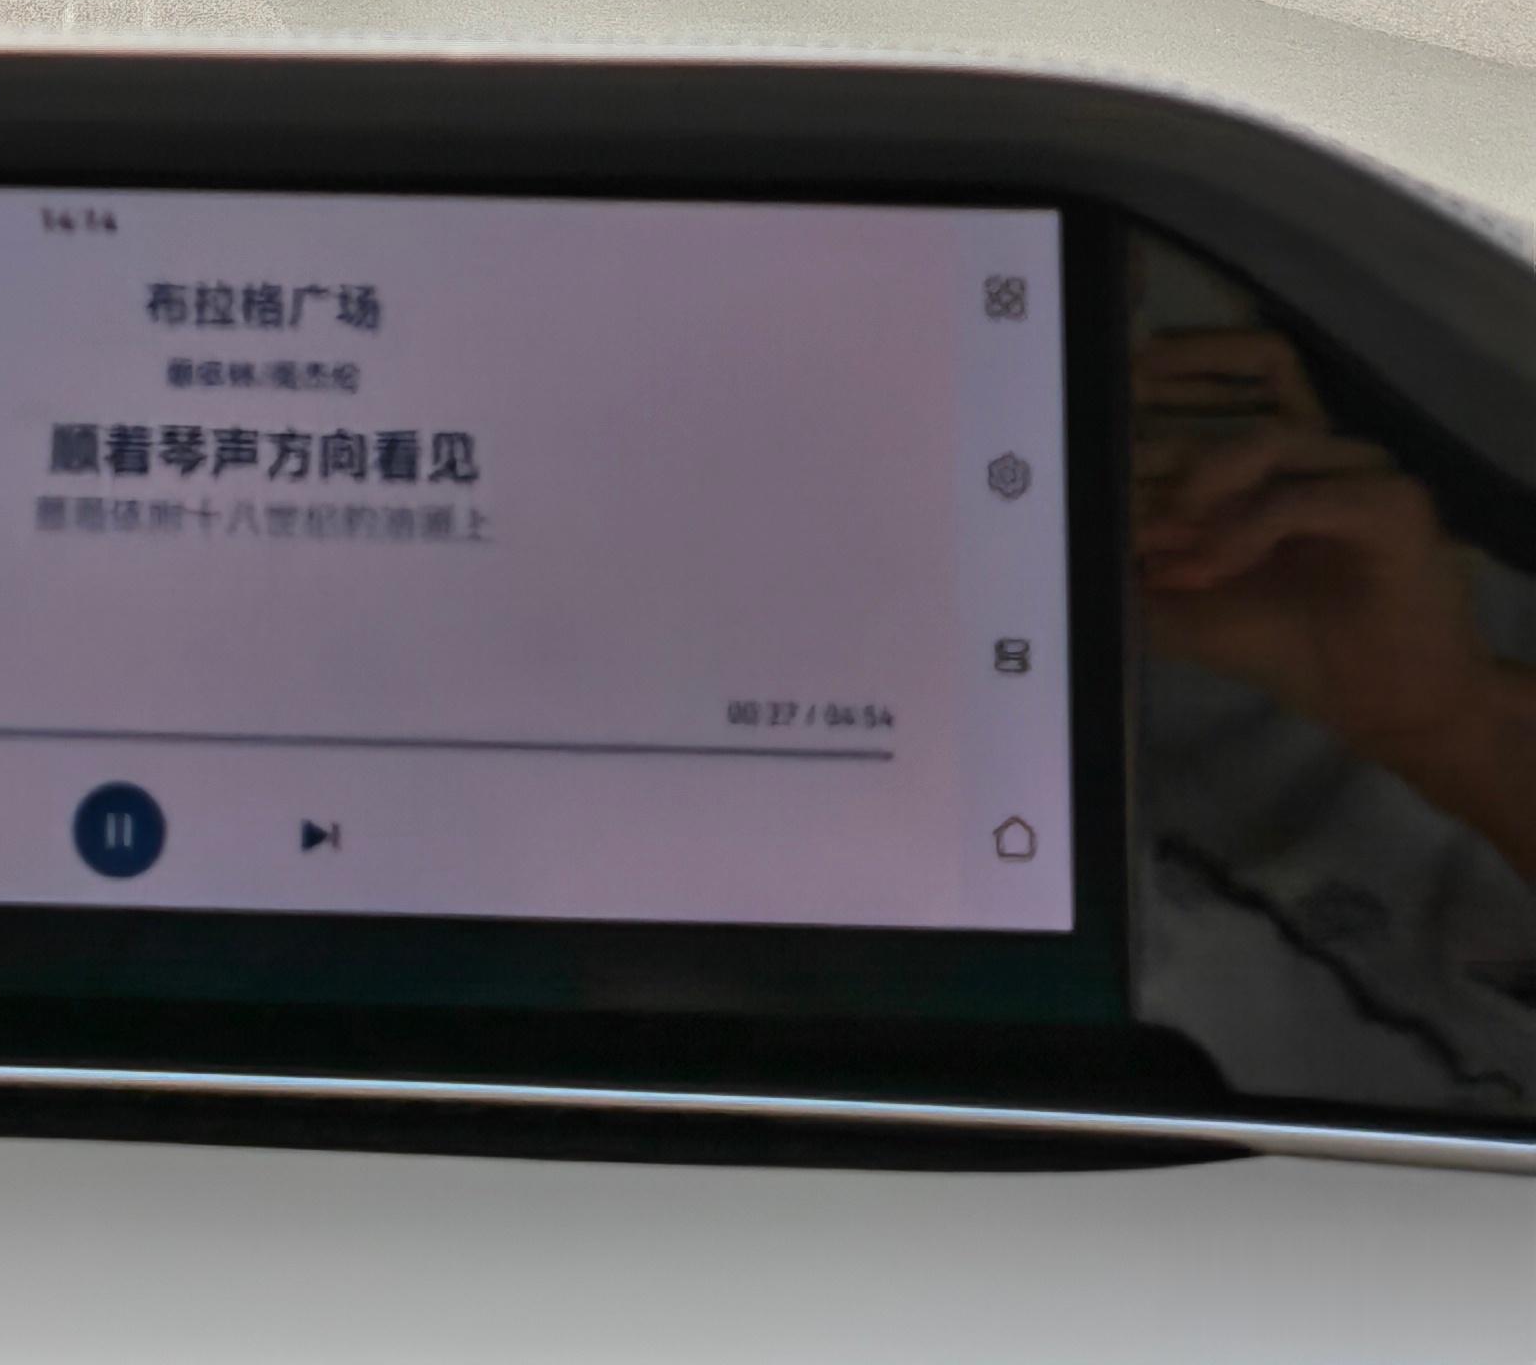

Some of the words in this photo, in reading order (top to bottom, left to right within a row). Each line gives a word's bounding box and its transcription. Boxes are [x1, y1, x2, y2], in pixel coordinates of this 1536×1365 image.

[144, 281, 383, 332] 布拉格广场
[50, 422, 482, 486] 顺着琴声方向看见
